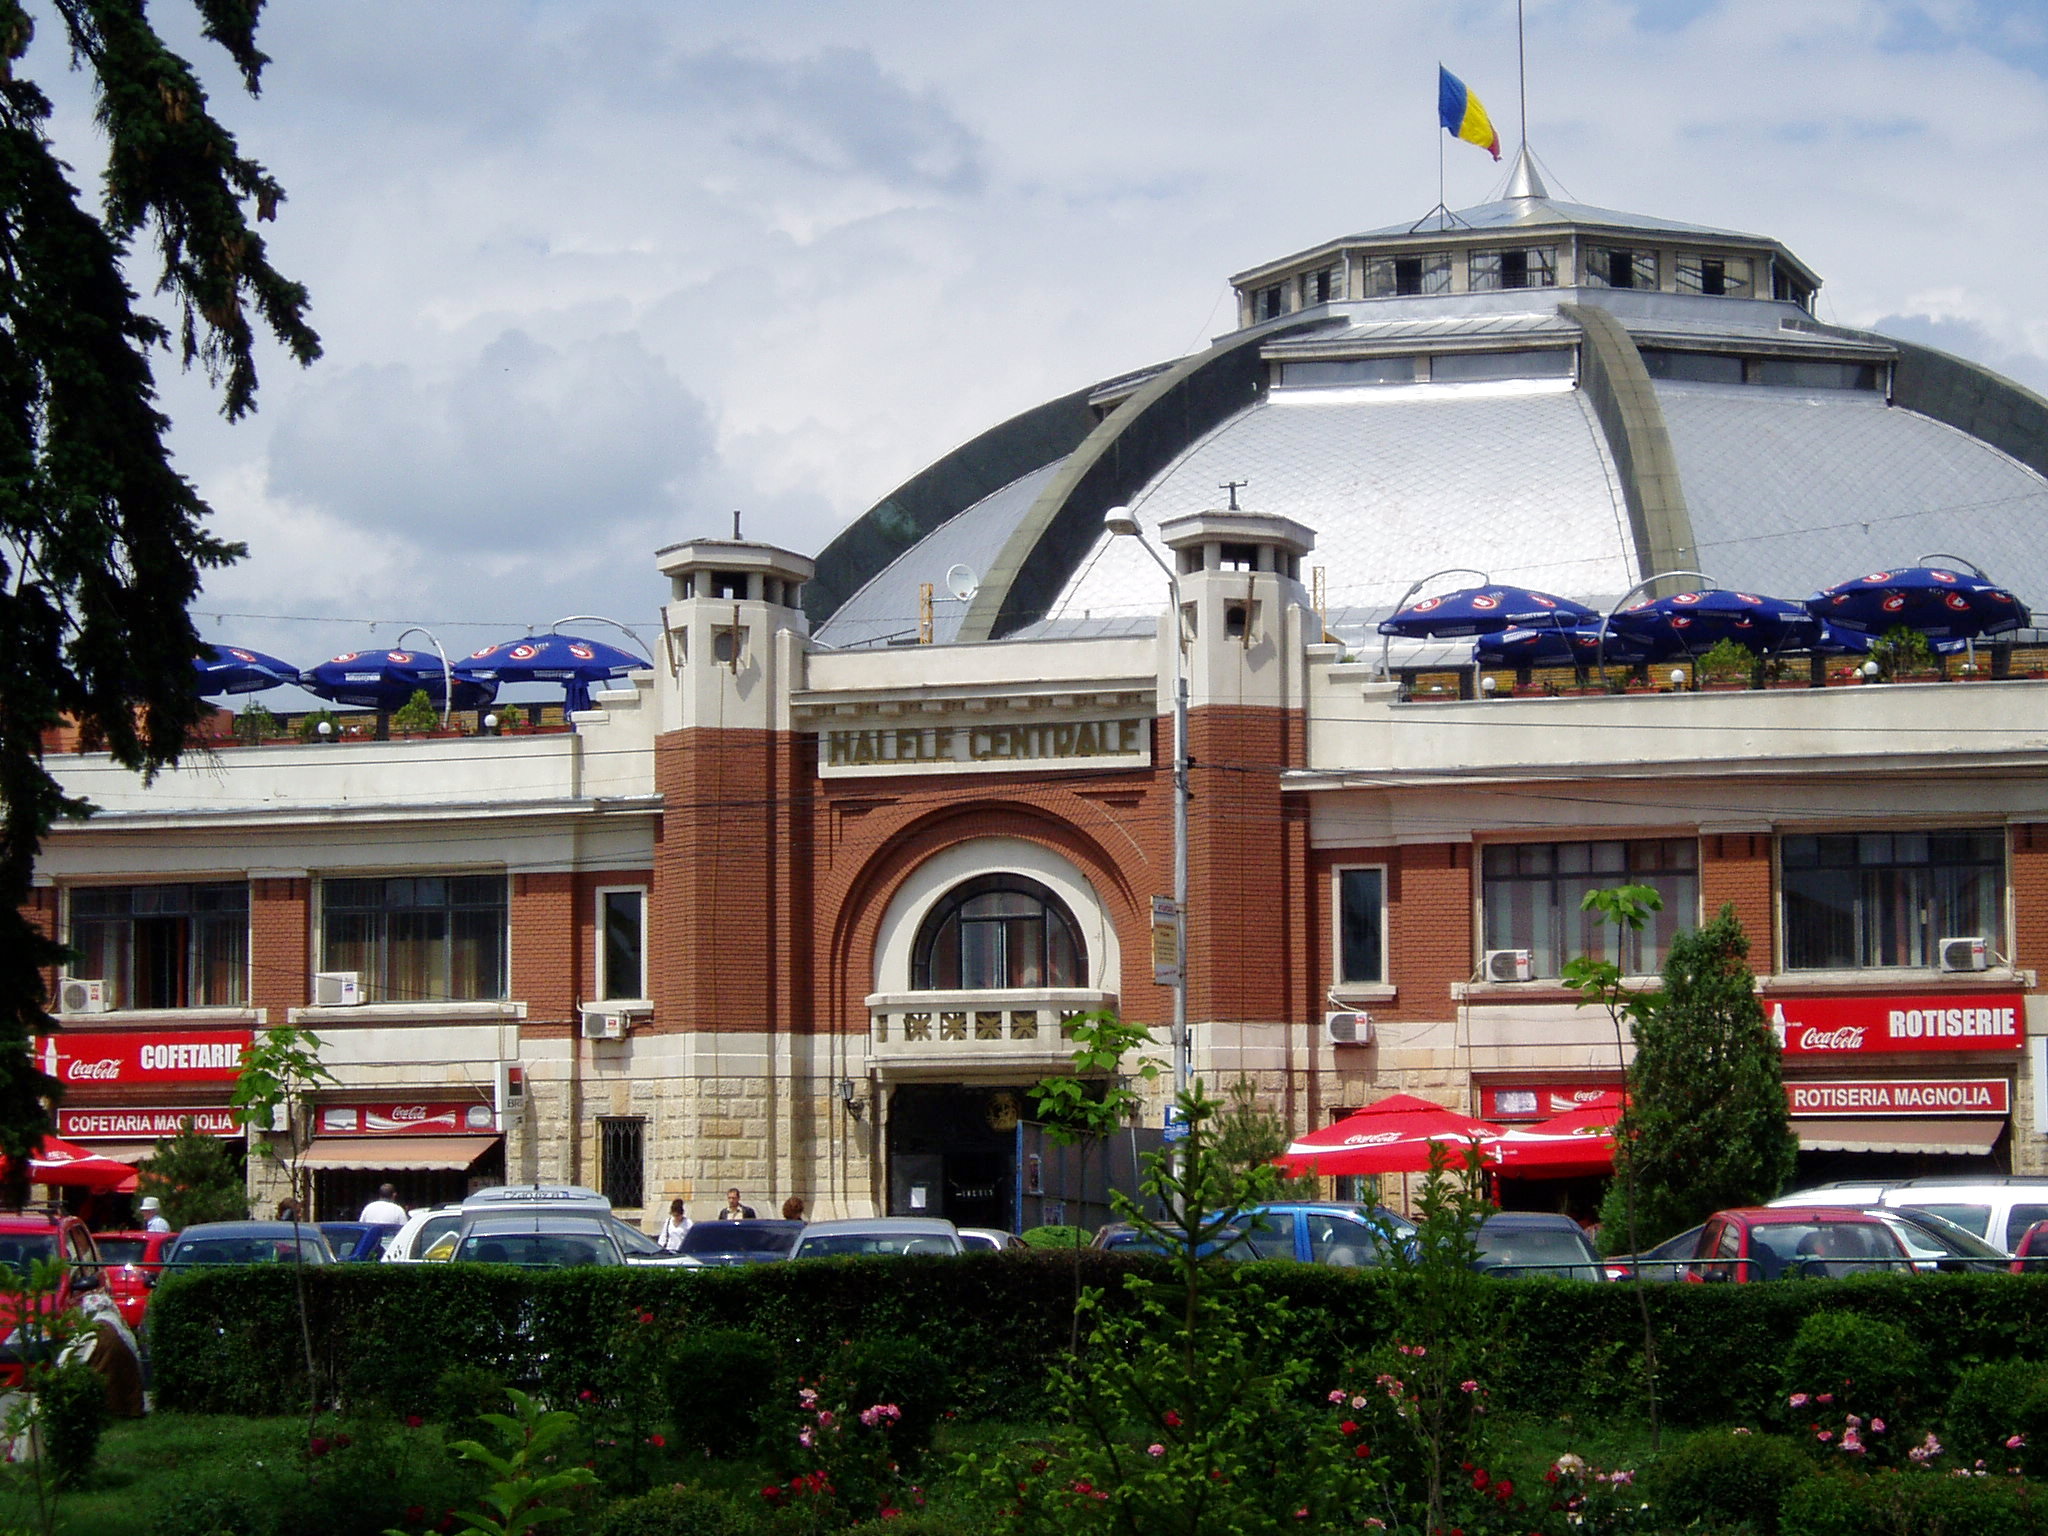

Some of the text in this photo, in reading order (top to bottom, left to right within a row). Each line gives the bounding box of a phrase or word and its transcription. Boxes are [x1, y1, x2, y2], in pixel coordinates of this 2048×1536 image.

[828, 718, 1140, 766] HALELE CENTRALE
[1889, 1008, 2015, 1038] ROTISERIE
[1800, 1026, 1868, 1049] Coca-Cola
[141, 1044, 243, 1069] COFETARIE
[68, 1058, 124, 1080] Coca-Cola
[1794, 1086, 1992, 1107] ROTISERIA MAGNOLIA
[69, 1115, 151, 1132] COFETARIA
